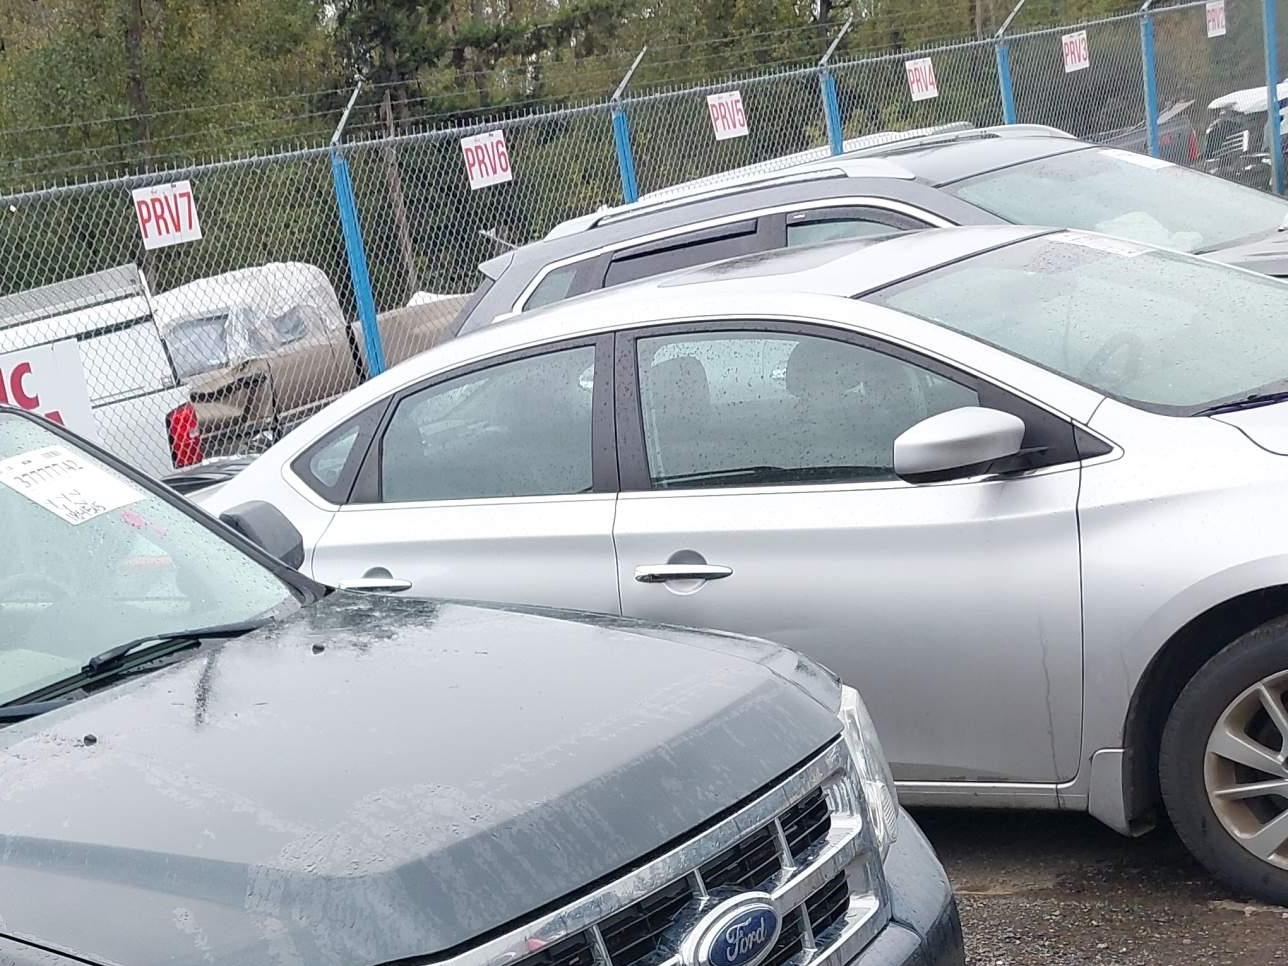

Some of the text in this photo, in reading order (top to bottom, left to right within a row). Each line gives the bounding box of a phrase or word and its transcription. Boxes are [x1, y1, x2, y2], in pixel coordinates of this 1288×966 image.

[1064, 37, 1087, 65] PRV3
[908, 64, 936, 94] PRV4
[710, 99, 746, 133] PRV5
[464, 140, 508, 180] PRV6
[136, 191, 192, 239] PRV7
[726, 917, 767, 962] Ford
